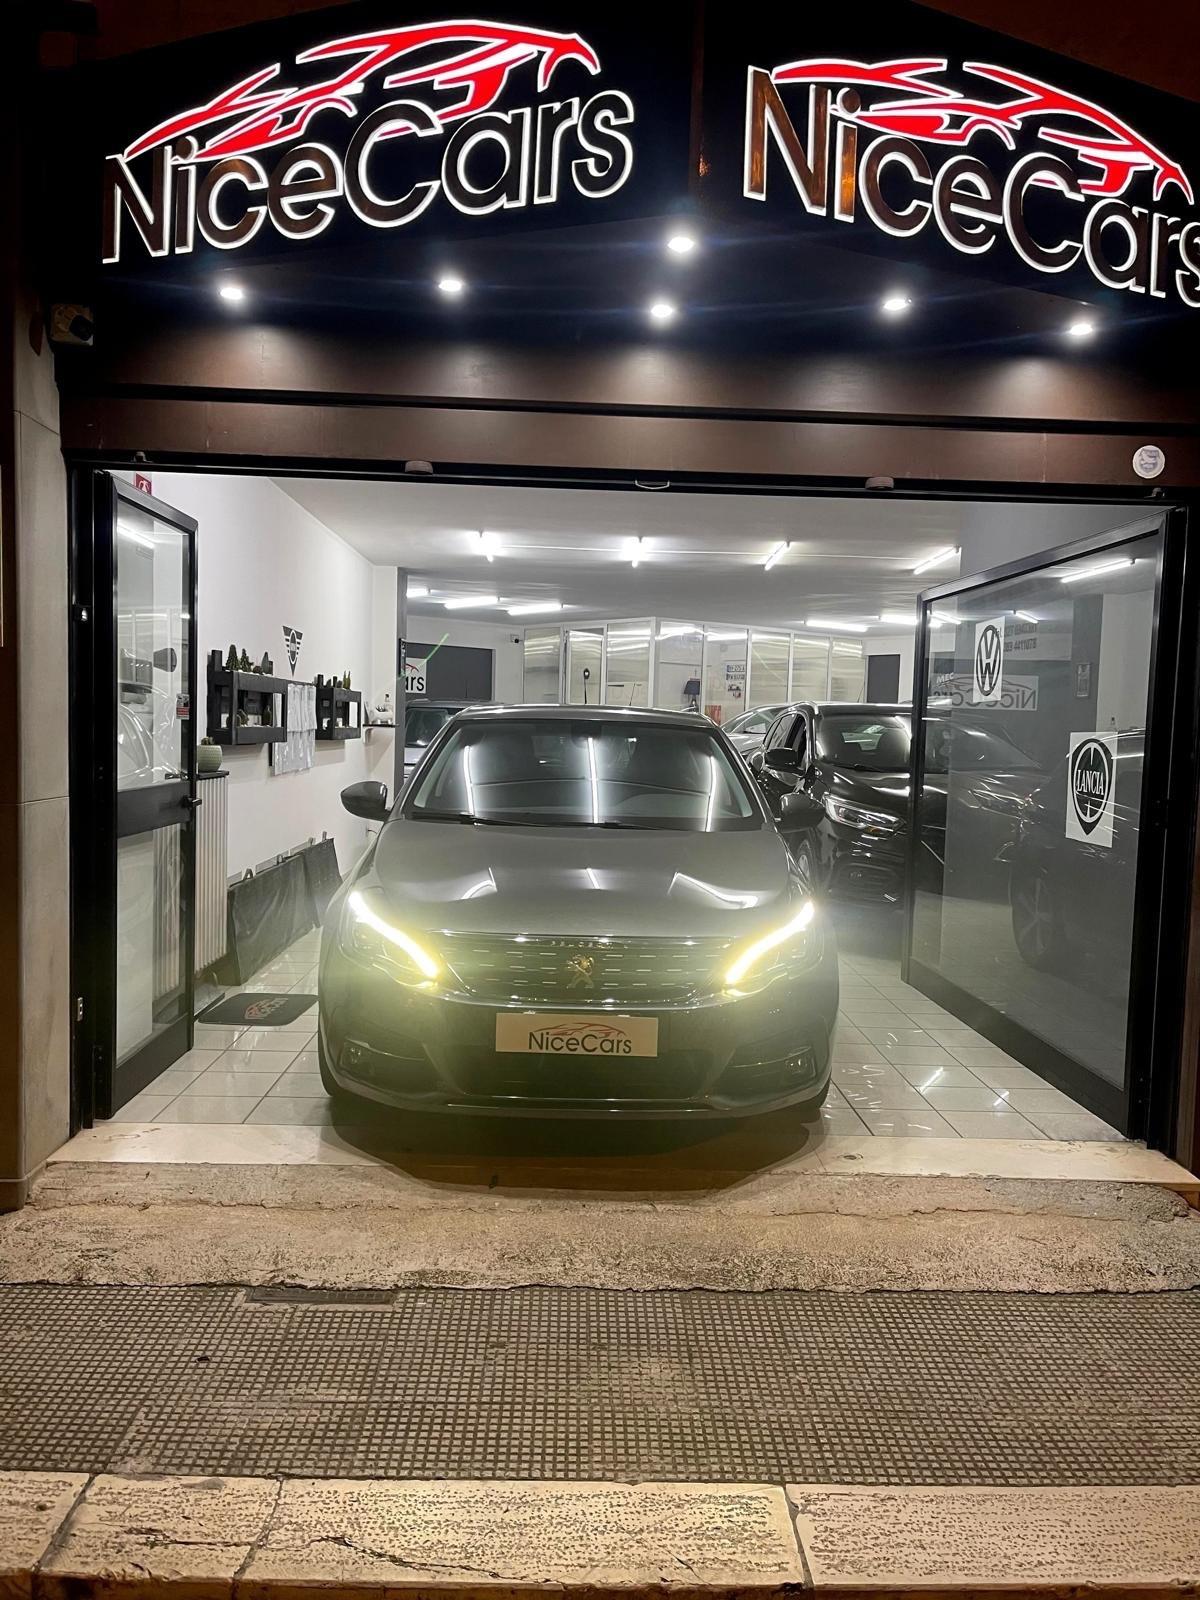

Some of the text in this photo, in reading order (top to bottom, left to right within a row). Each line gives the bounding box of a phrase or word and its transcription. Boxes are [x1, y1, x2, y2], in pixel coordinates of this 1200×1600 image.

[102, 88, 636, 264] NiceCars
[743, 66, 1200, 309] NiceCars
[1077, 769, 1104, 795] LANCIA
[528, 1031, 632, 1054] NiceCars
